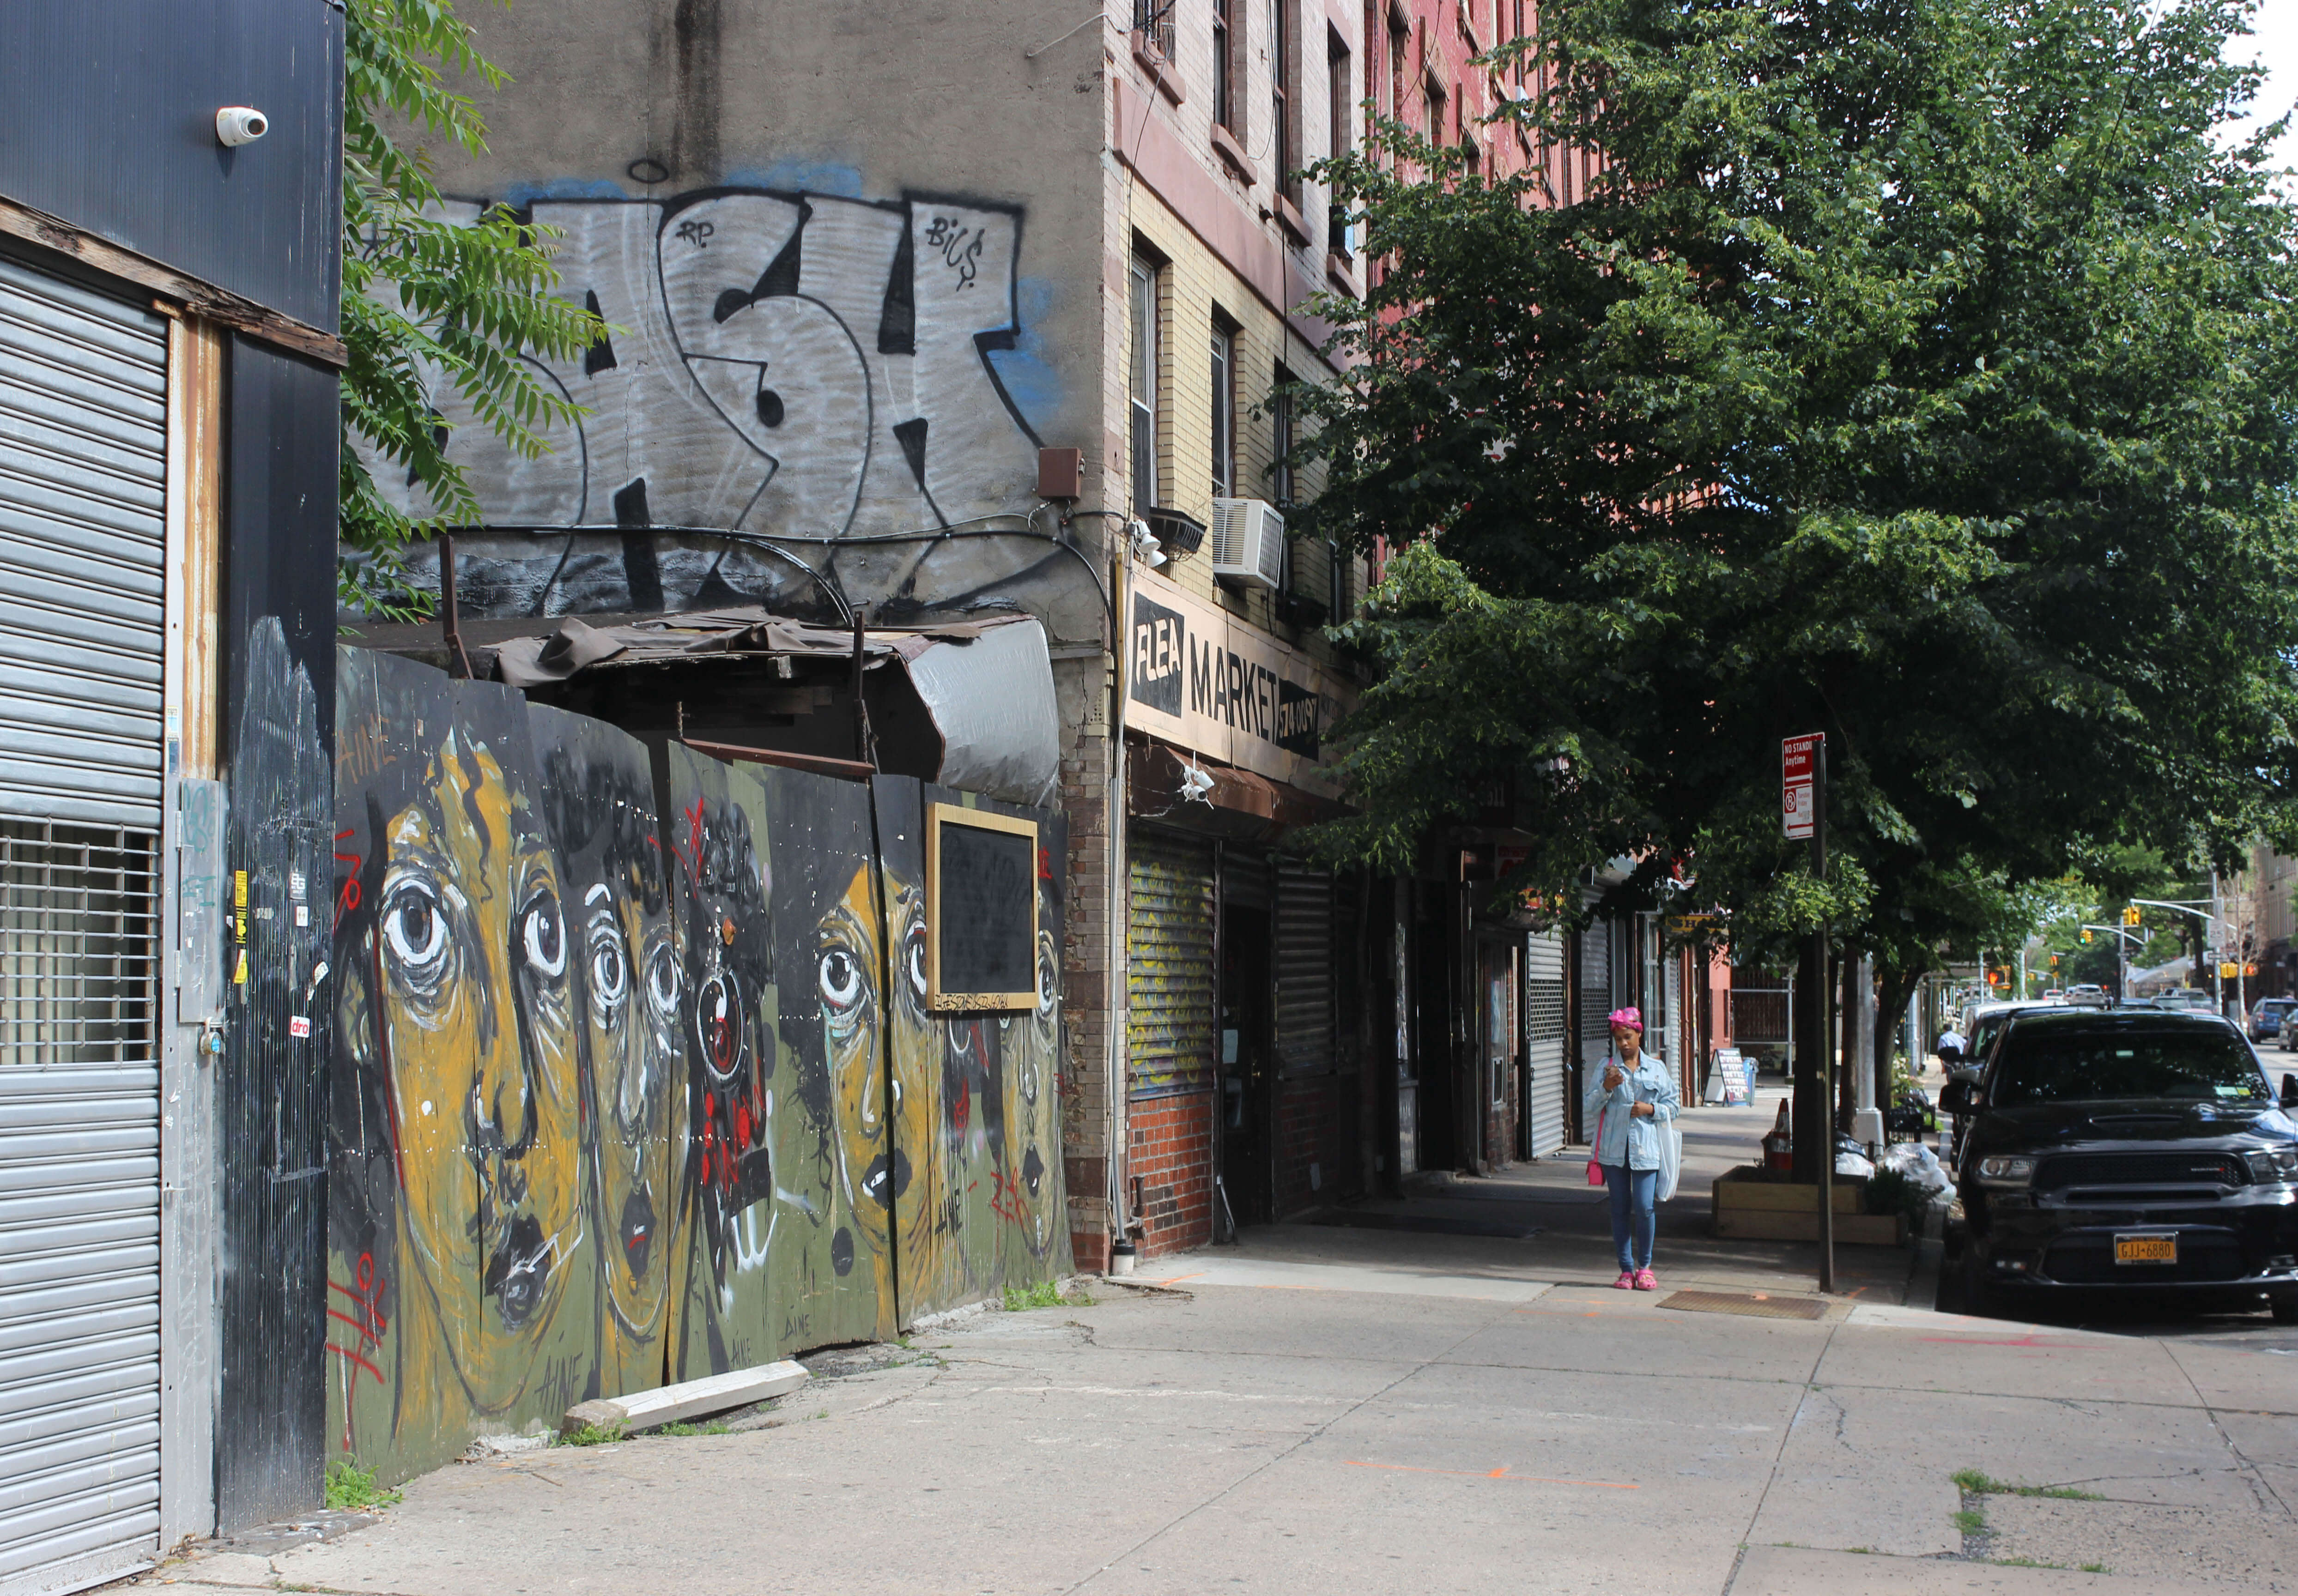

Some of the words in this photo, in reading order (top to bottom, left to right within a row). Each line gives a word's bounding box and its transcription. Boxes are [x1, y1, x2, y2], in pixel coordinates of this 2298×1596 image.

[1136, 617, 1181, 686] FLEA
[1190, 632, 1277, 745] MARKET
[1785, 744, 1792, 754] NO
[1793, 741, 1813, 753] STANDI
[1785, 755, 1806, 768] Anytime
[292, 1019, 308, 1034] dro
[779, 1313, 812, 1342] AINE
[731, 1337, 752, 1368] AINE
